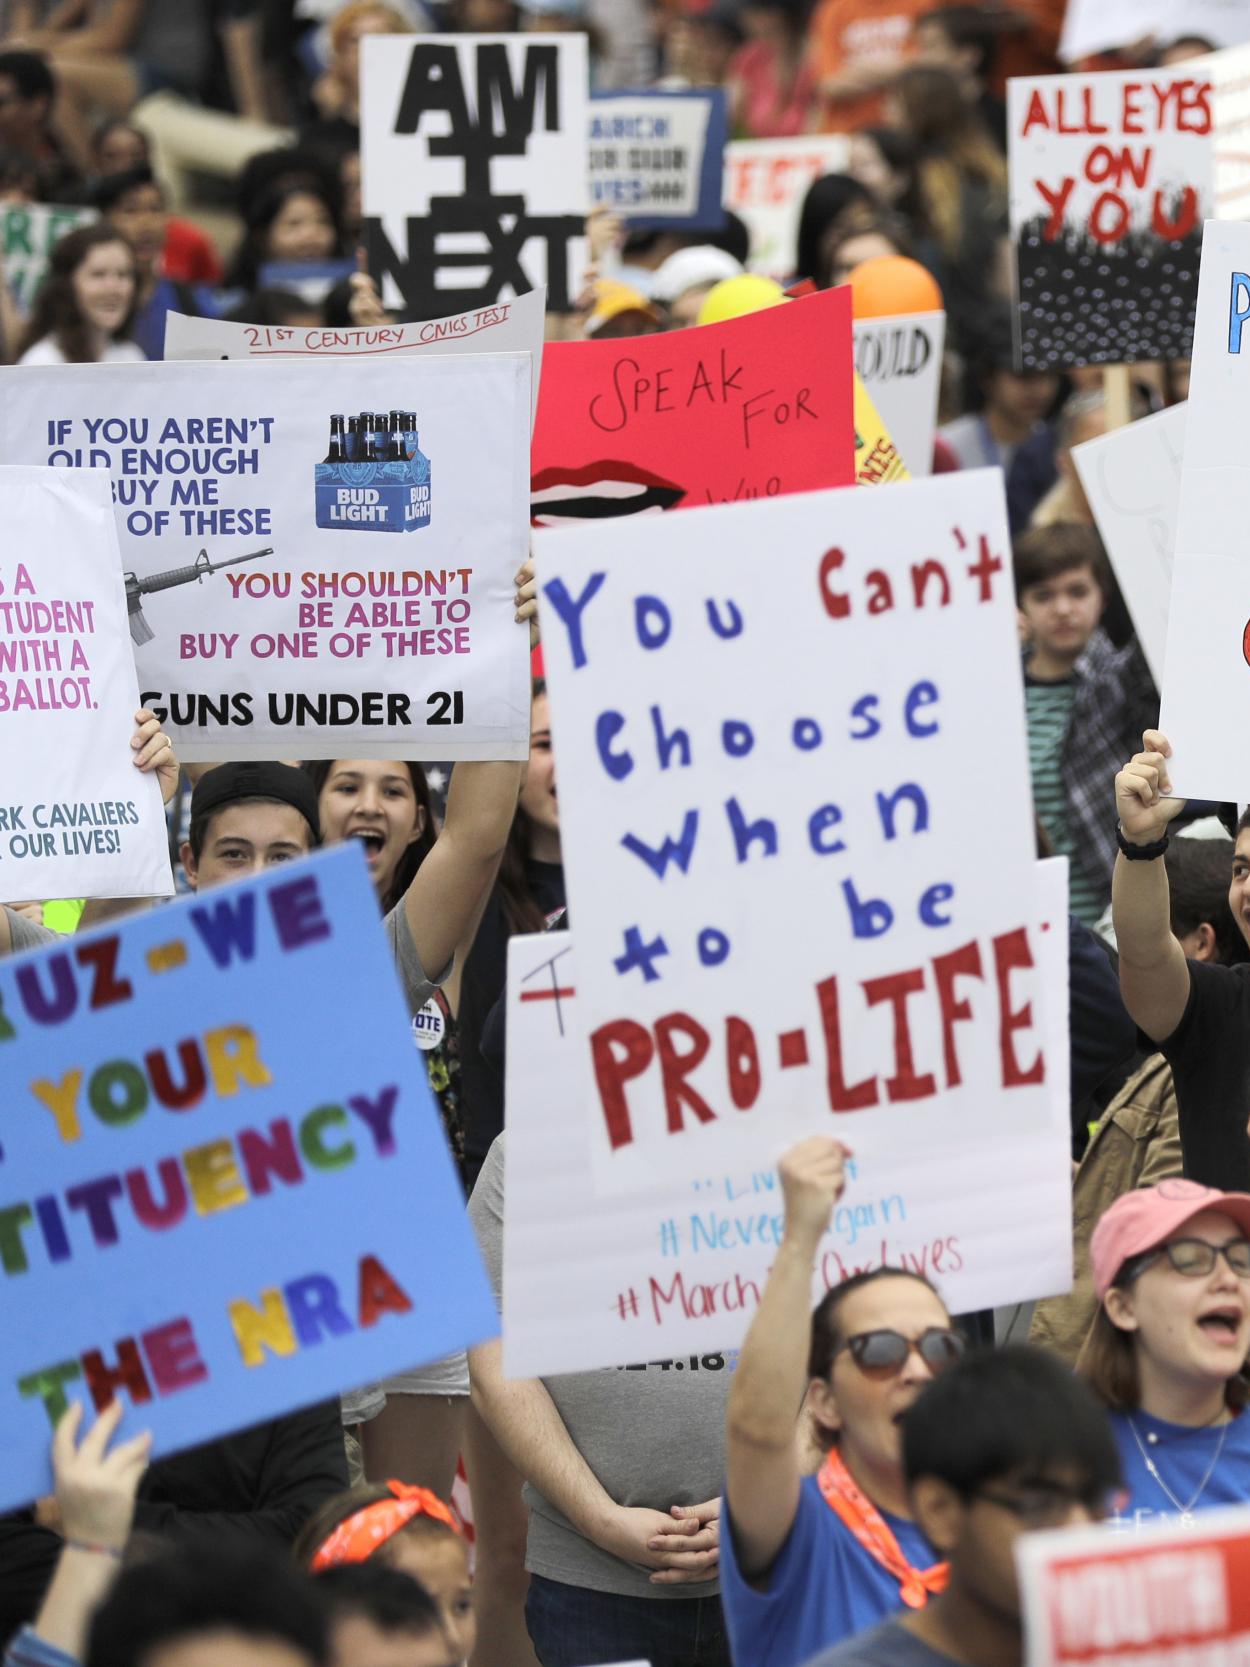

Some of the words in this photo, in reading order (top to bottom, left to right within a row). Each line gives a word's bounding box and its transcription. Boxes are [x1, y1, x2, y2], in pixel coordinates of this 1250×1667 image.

[394, 43, 561, 136] AM
[1023, 88, 1107, 138] ALL
[1121, 79, 1214, 136] EYES
[426, 134, 527, 217] I
[1085, 144, 1154, 190] ON
[1035, 176, 1198, 244] YOU
[364, 213, 587, 321] NEXT
[244, 327, 294, 348] 21ST
[304, 327, 405, 351] CENTURY
[473, 303, 513, 328] TEST
[589, 347, 744, 433] SPEAK
[742, 386, 820, 449] FOR
[47, 418, 73, 447] IF
[82, 417, 151, 445] YOU
[158, 416, 276, 446] AREN'T
[121, 447, 260, 476] ENOUGH
[106, 478, 161, 506] BUY
[169, 478, 220, 506] ME
[336, 488, 380, 505] BUD
[410, 485, 430, 504] BUD
[126, 509, 170, 537] OF
[180, 508, 273, 537] THESE
[329, 505, 390, 522] LIGHT
[404, 499, 432, 521] LIGHT
[13, 563, 36, 596] A
[226, 572, 292, 600] YOU
[300, 567, 473, 599] SHOULDN'T
[299, 602, 334, 629] BE
[344, 601, 421, 629] ABLE
[430, 598, 472, 625] TO
[541, 571, 746, 671] You
[817, 525, 1003, 621] Can't
[70, 638, 91, 672] A
[180, 633, 239, 660] BUY
[249, 631, 319, 660] ONE
[328, 630, 372, 658] OF
[381, 626, 472, 658] THESE
[139, 692, 255, 728] GUNS
[268, 691, 412, 727] UNDER
[426, 691, 465, 726] 21
[593, 678, 942, 783] Choose
[32, 800, 140, 829] CAVALIERS
[9, 832, 58, 858] OUR
[64, 830, 121, 856] LIVES!
[612, 924, 732, 984] to
[839, 876, 956, 940] be
[414, 1013, 442, 1033] OTE
[588, 924, 1048, 1155] PRO-LIFE
[30, 1022, 273, 1144] YOUR
[17, 1316, 210, 1431] THE
[227, 1252, 414, 1368] NRA
